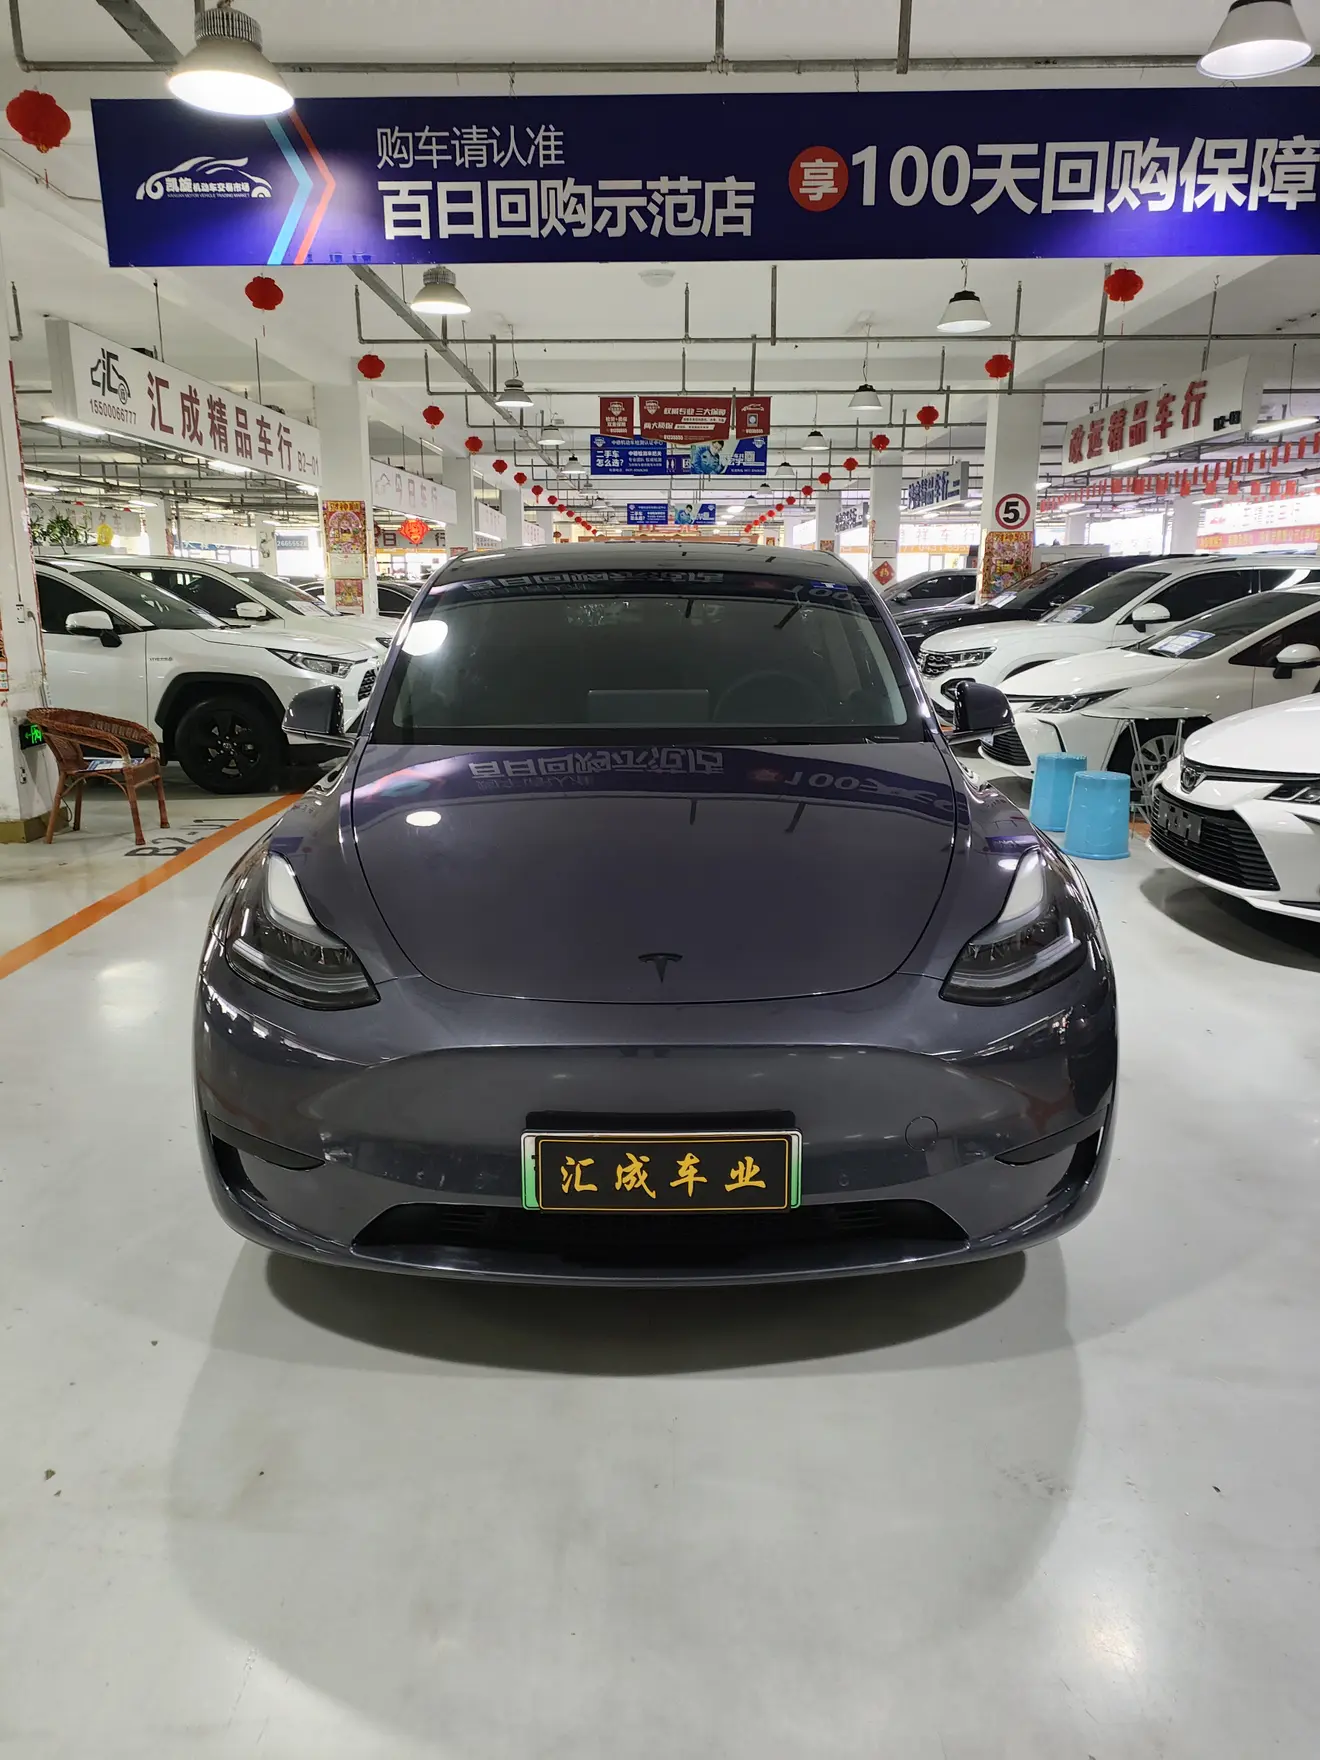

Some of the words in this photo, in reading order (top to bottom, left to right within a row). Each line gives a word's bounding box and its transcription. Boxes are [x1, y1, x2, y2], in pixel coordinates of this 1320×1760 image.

[376, 124, 565, 170] 购车请认准
[799, 158, 838, 202] 享
[851, 135, 1320, 215] 100天回购保障
[377, 176, 755, 240] 百日回购示范店
[89, 398, 137, 425] 15500066777
[147, 371, 293, 472] 汇成精品车行
[1002, 501, 1020, 523] 5
[560, 1152, 766, 1199] 汇成车业
